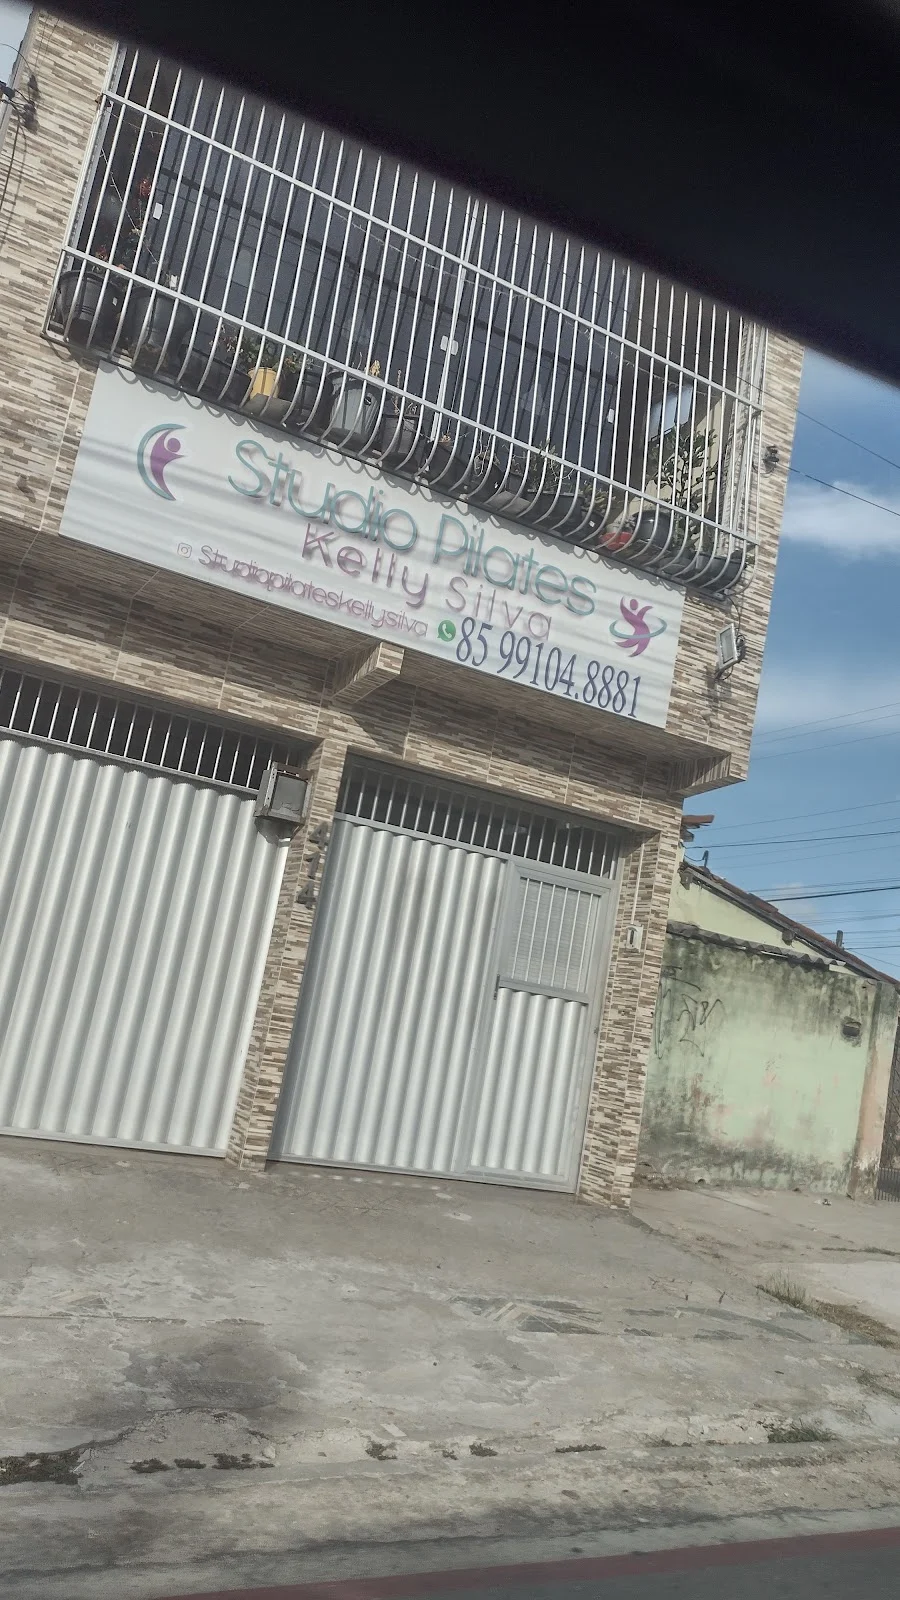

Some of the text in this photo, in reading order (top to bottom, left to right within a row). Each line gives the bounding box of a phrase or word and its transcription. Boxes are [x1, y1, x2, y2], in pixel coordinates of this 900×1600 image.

[227, 439, 598, 616] Studio Pilates
[301, 522, 553, 641] Kelly Silva
[455, 616, 641, 719] 85 99104.8881
